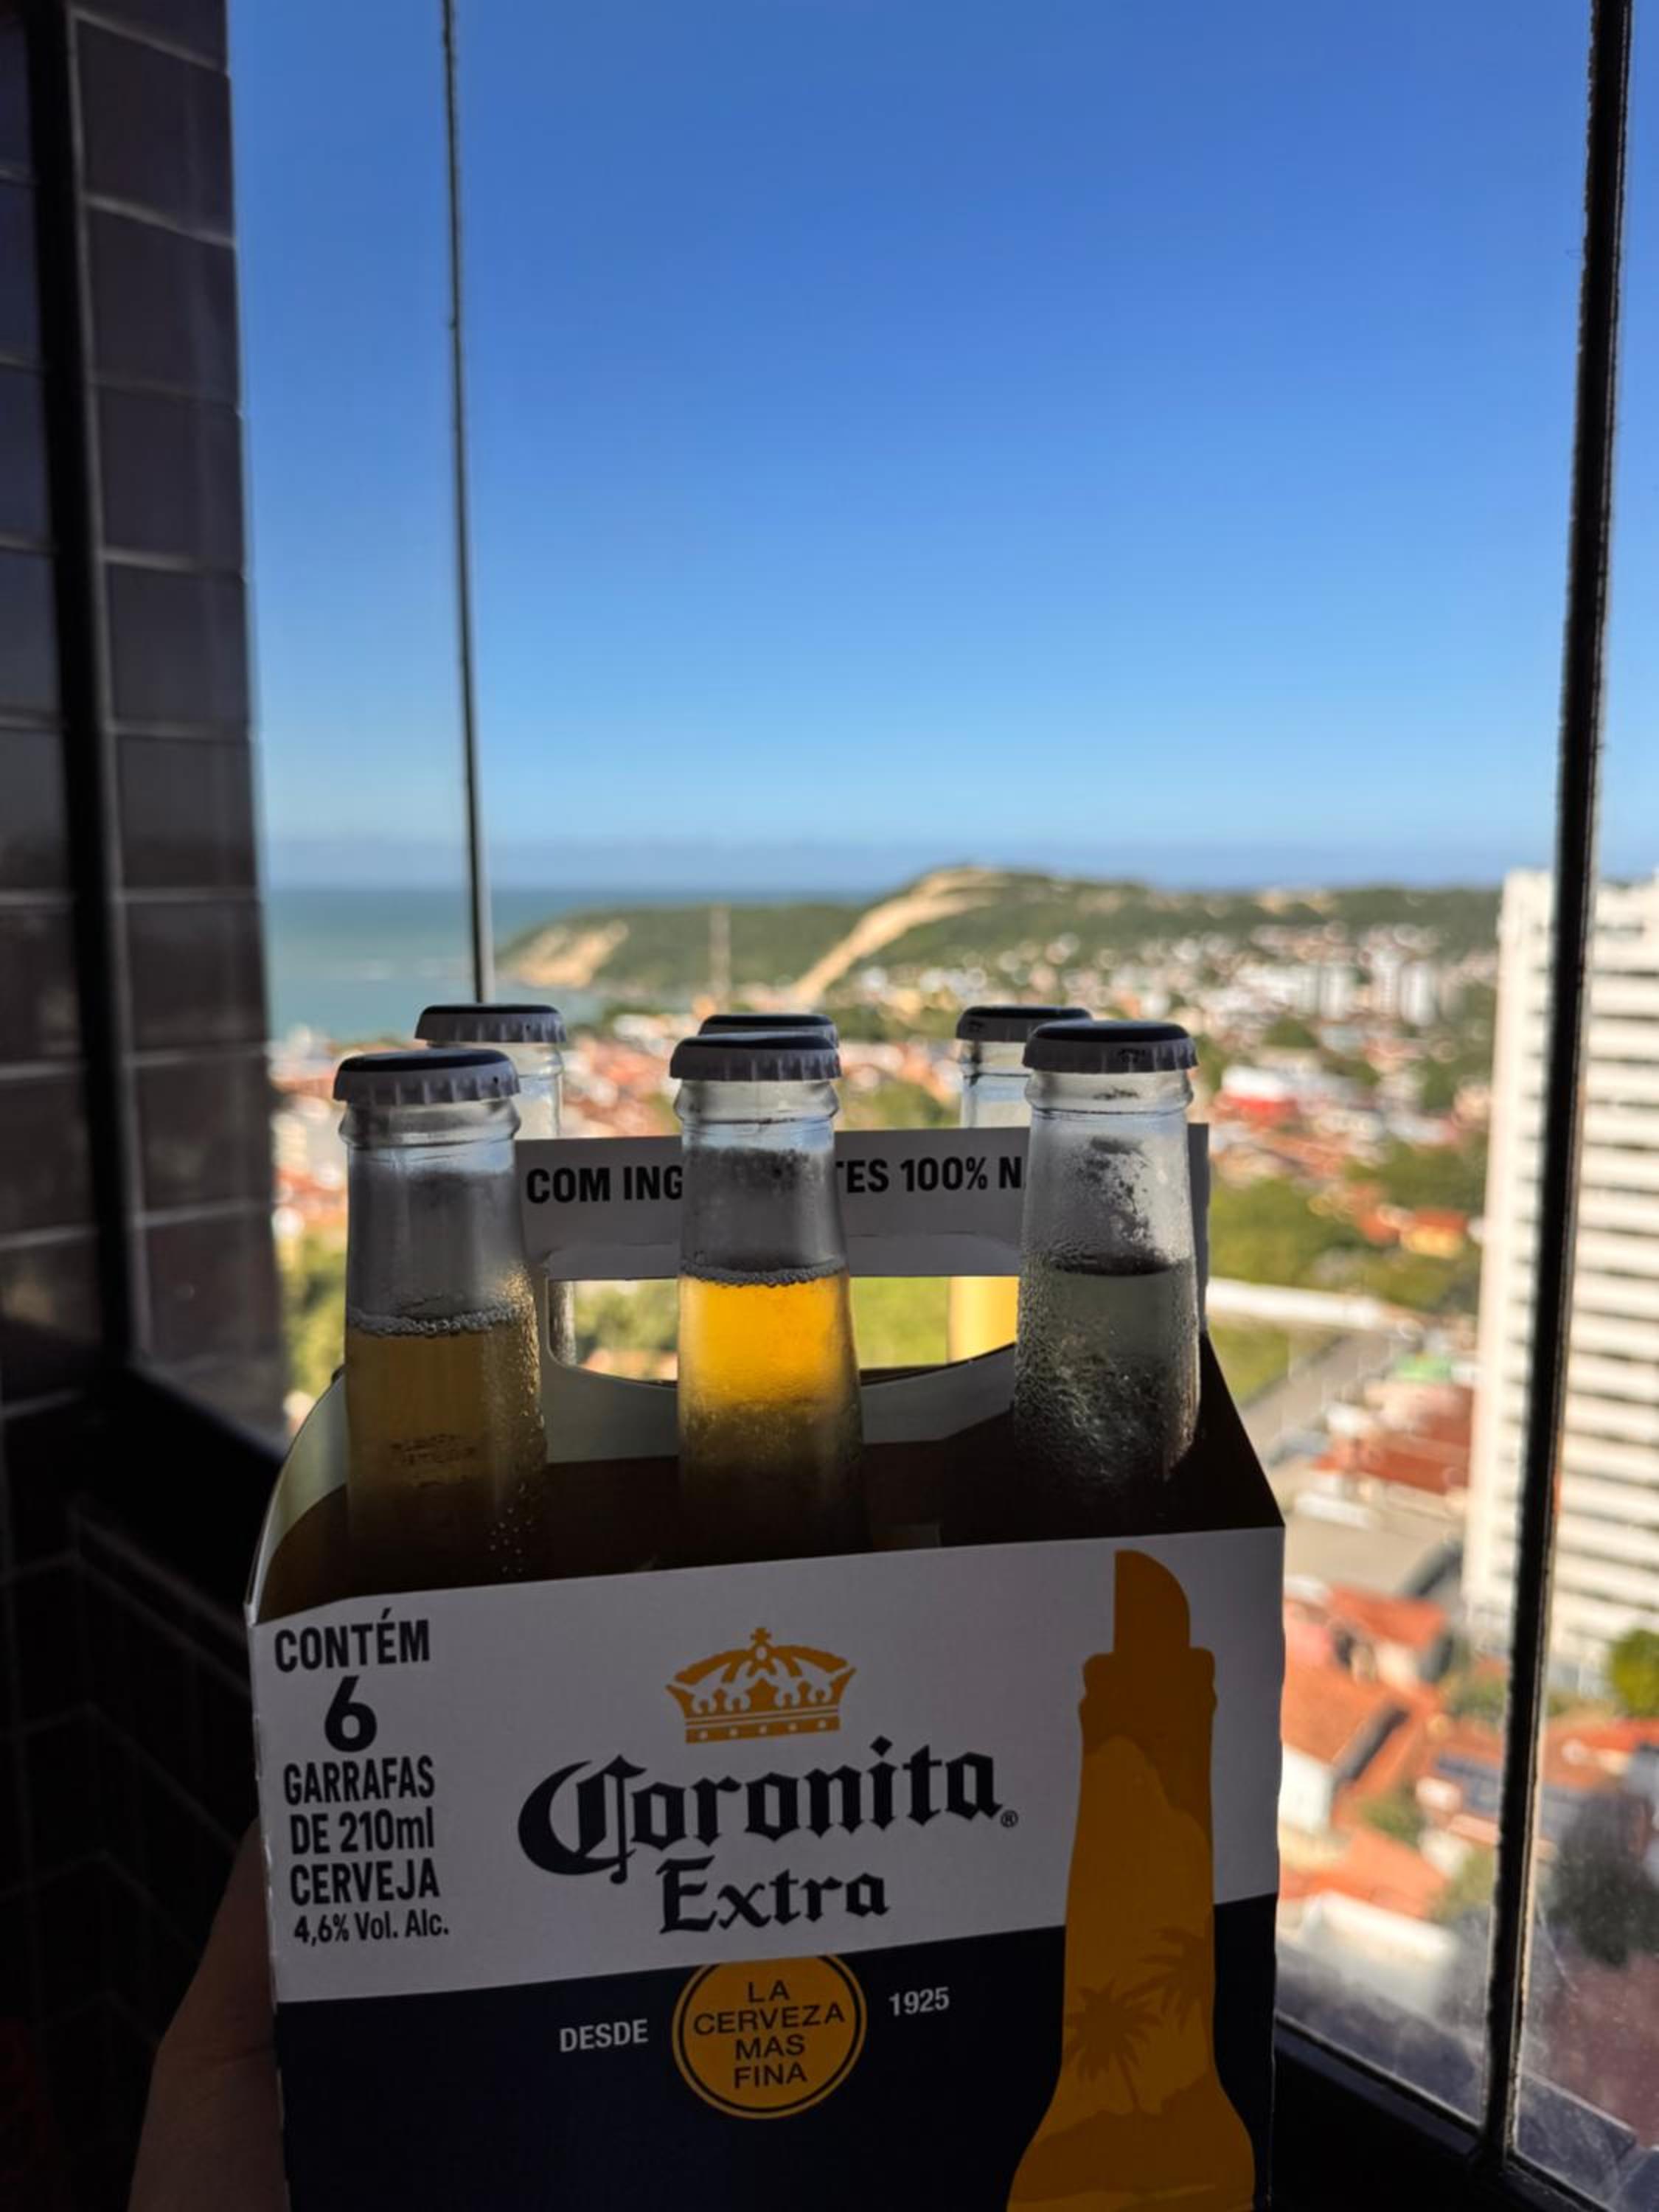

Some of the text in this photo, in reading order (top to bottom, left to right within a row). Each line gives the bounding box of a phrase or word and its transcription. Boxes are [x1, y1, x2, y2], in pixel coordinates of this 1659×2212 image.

[526, 1167, 611, 1204] COM
[900, 1156, 988, 1192] 100%
[274, 1607, 431, 1672] CONTÉM
[324, 1675, 378, 1753] 6
[284, 1755, 435, 1805] GARRAFAS
[290, 1806, 435, 1855] DE 210ml
[518, 1735, 1003, 1885] Coronita
[290, 1858, 440, 1906] CERVEJA
[655, 1855, 890, 1935] Extra
[293, 1909, 449, 1947] 4,6% Vol. Alc.
[748, 1980, 790, 2003] LA
[560, 1986, 950, 2053] DESDE 1925
[693, 2001, 846, 2036] CERVEZA
[736, 2034, 806, 2061] MAS
[734, 2061, 807, 2089] FINA
